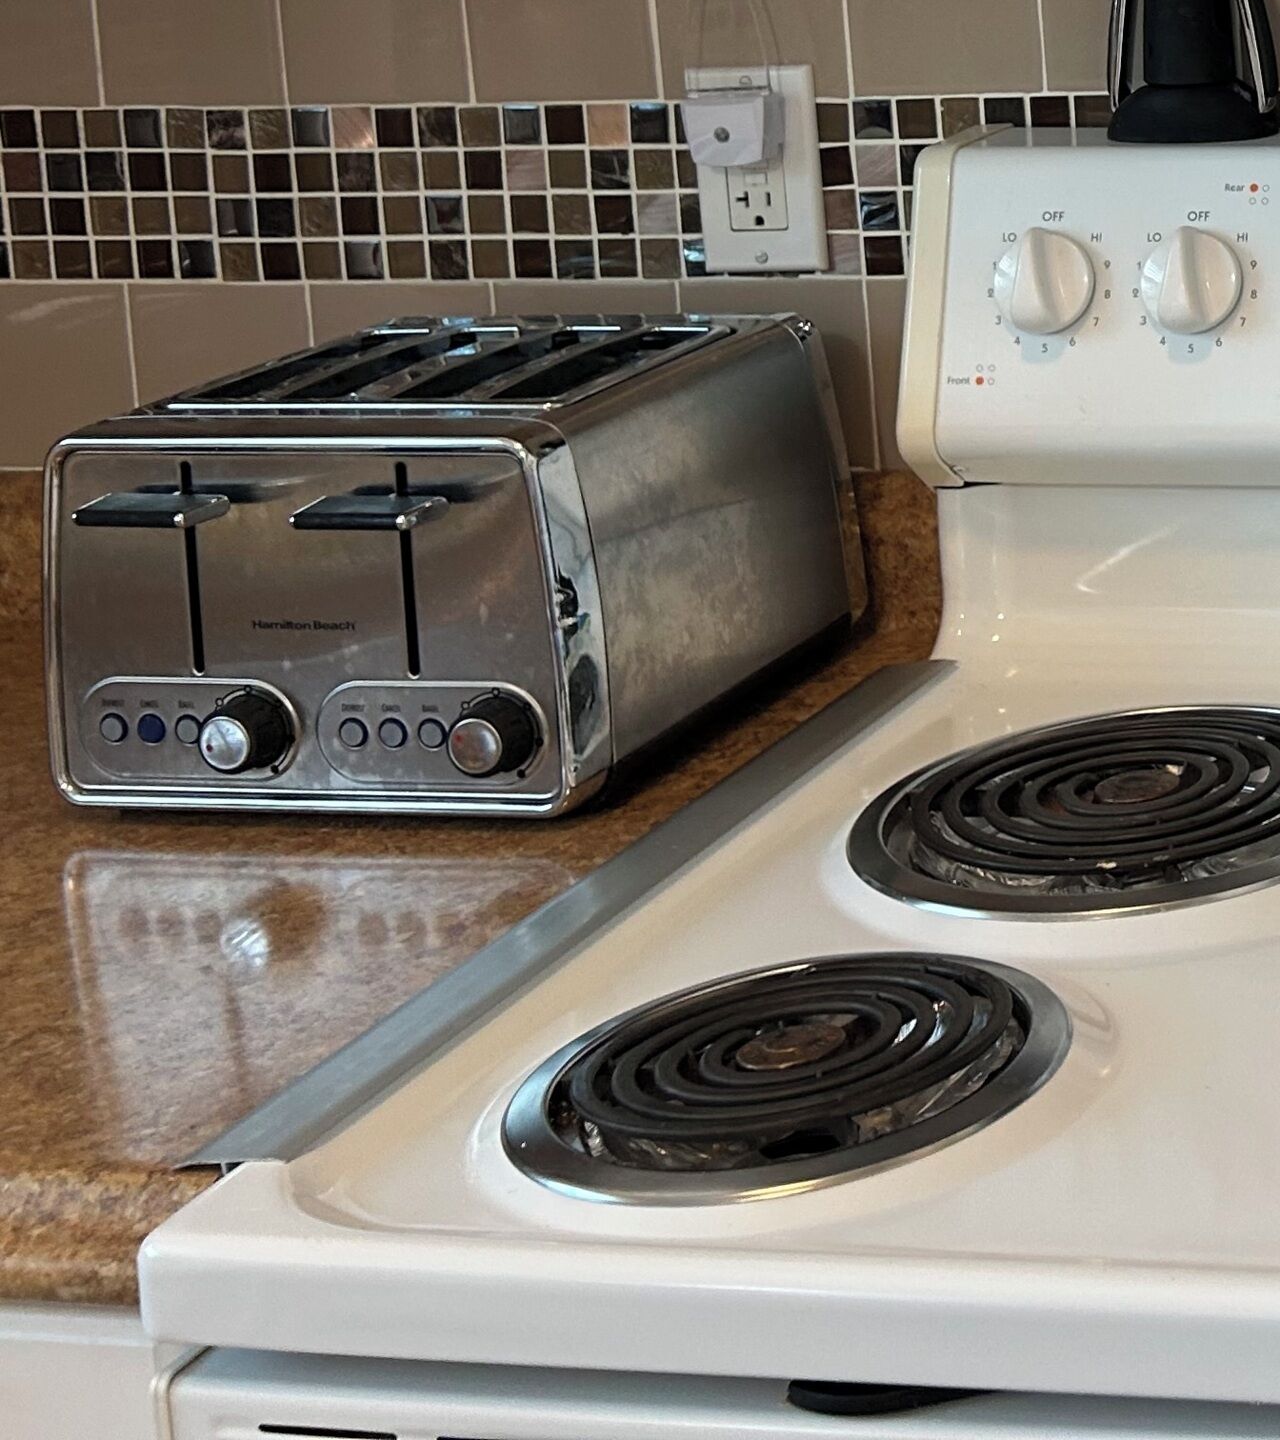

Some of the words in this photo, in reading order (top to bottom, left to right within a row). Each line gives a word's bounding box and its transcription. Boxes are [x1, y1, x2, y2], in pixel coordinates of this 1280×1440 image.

[1224, 183, 1245, 192] Rear
[1042, 211, 1065, 222] OFF
[1187, 211, 1210, 222] OFF
[1002, 232, 1018, 243] LO
[1090, 232, 1103, 243] HI
[1147, 232, 1162, 243] LO
[1236, 232, 1249, 243] HI
[1104, 260, 1111, 270] 9
[1250, 260, 1258, 270] 9
[987, 288, 995, 298] 2
[1104, 289, 1111, 299] 8
[1132, 288, 1139, 298] 2
[1250, 289, 1258, 300] 8
[995, 315, 1002, 325] 3
[1093, 317, 1099, 327] 7
[1140, 315, 1147, 325] 3
[1240, 317, 1246, 327] 7
[1014, 336, 1021, 346] 4
[1069, 337, 1076, 347] 6
[1159, 336, 1166, 346] 4
[1215, 337, 1222, 347] 6
[1041, 343, 1049, 353] 5
[1187, 343, 1194, 354] 5
[947, 376, 970, 385] Front
[252, 620, 311, 631] Hamilton
[313, 620, 356, 631] Beach
